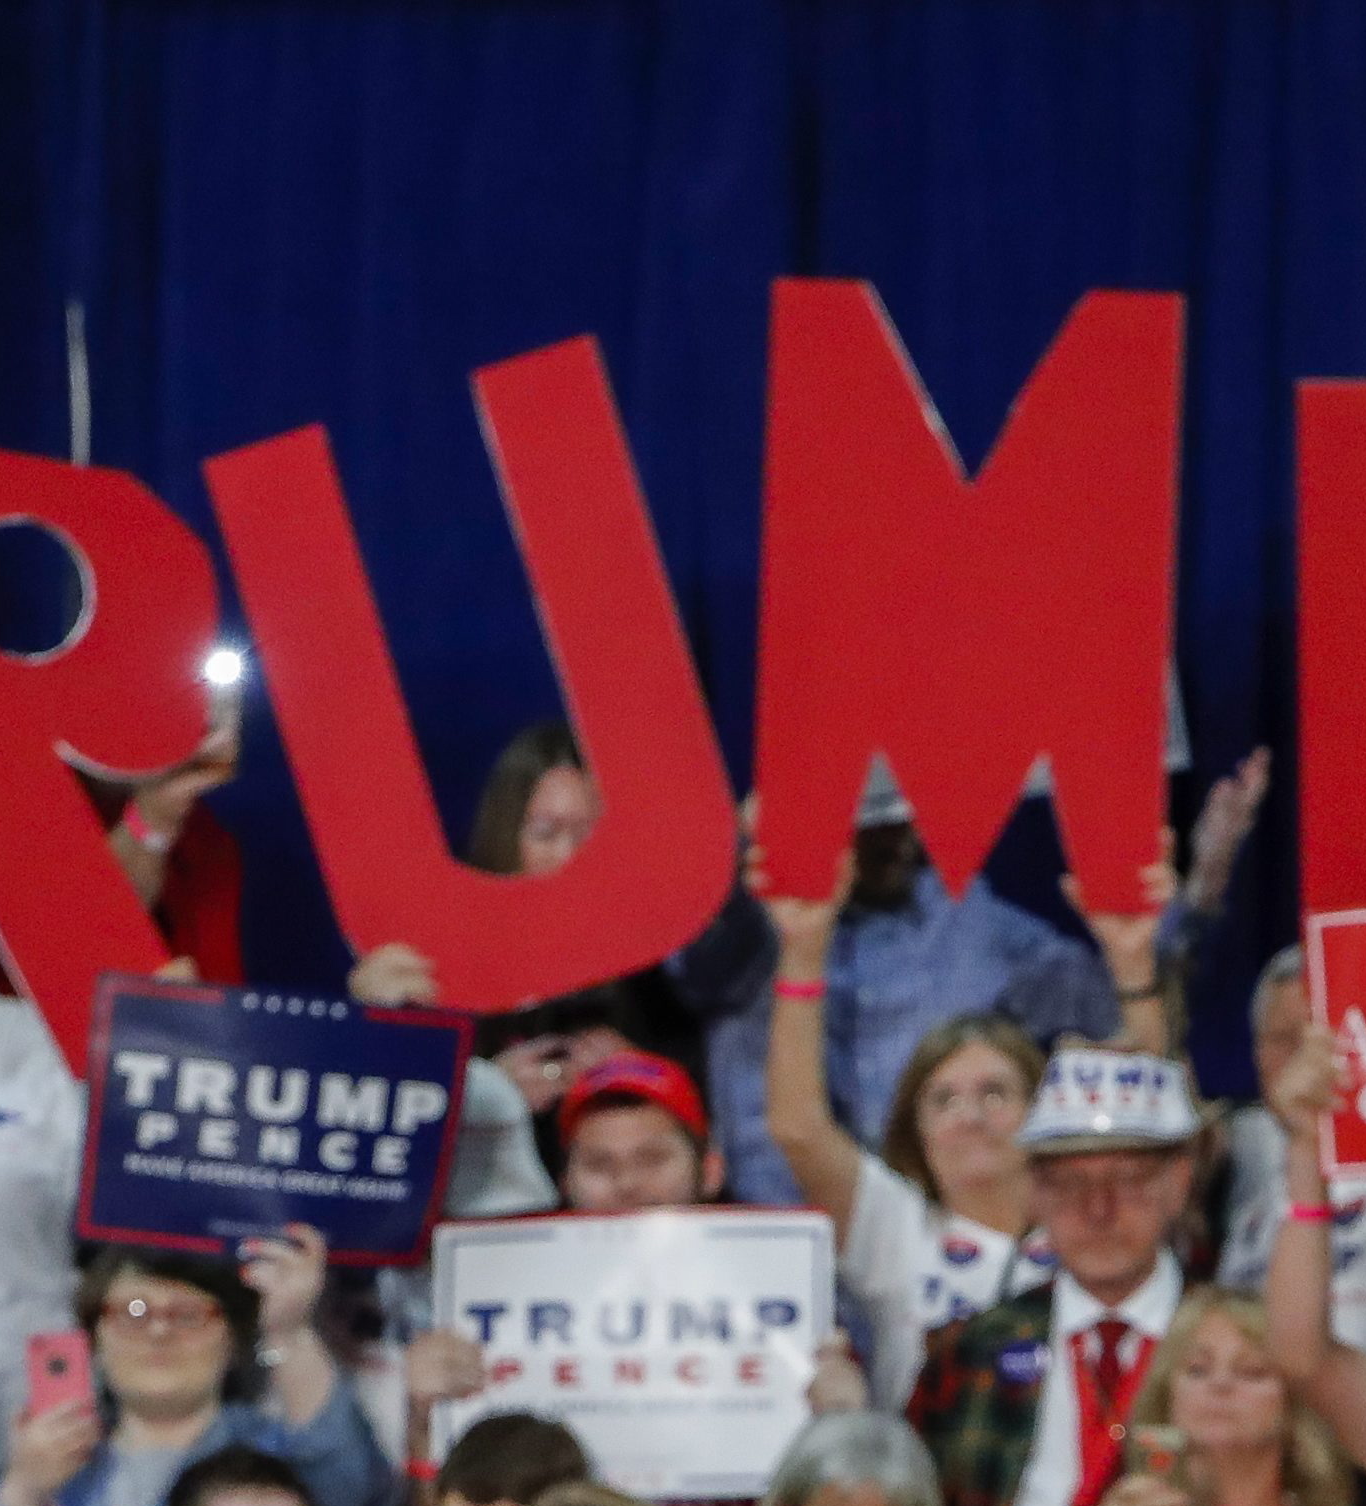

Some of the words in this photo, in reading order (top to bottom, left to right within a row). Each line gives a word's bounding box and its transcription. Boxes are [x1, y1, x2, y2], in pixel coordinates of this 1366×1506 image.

[113, 1050, 449, 1134] TRUMP
[137, 1109, 413, 1178] PENCE
[464, 1300, 799, 1345] TRUMP
[488, 1357, 767, 1388] PENCE
